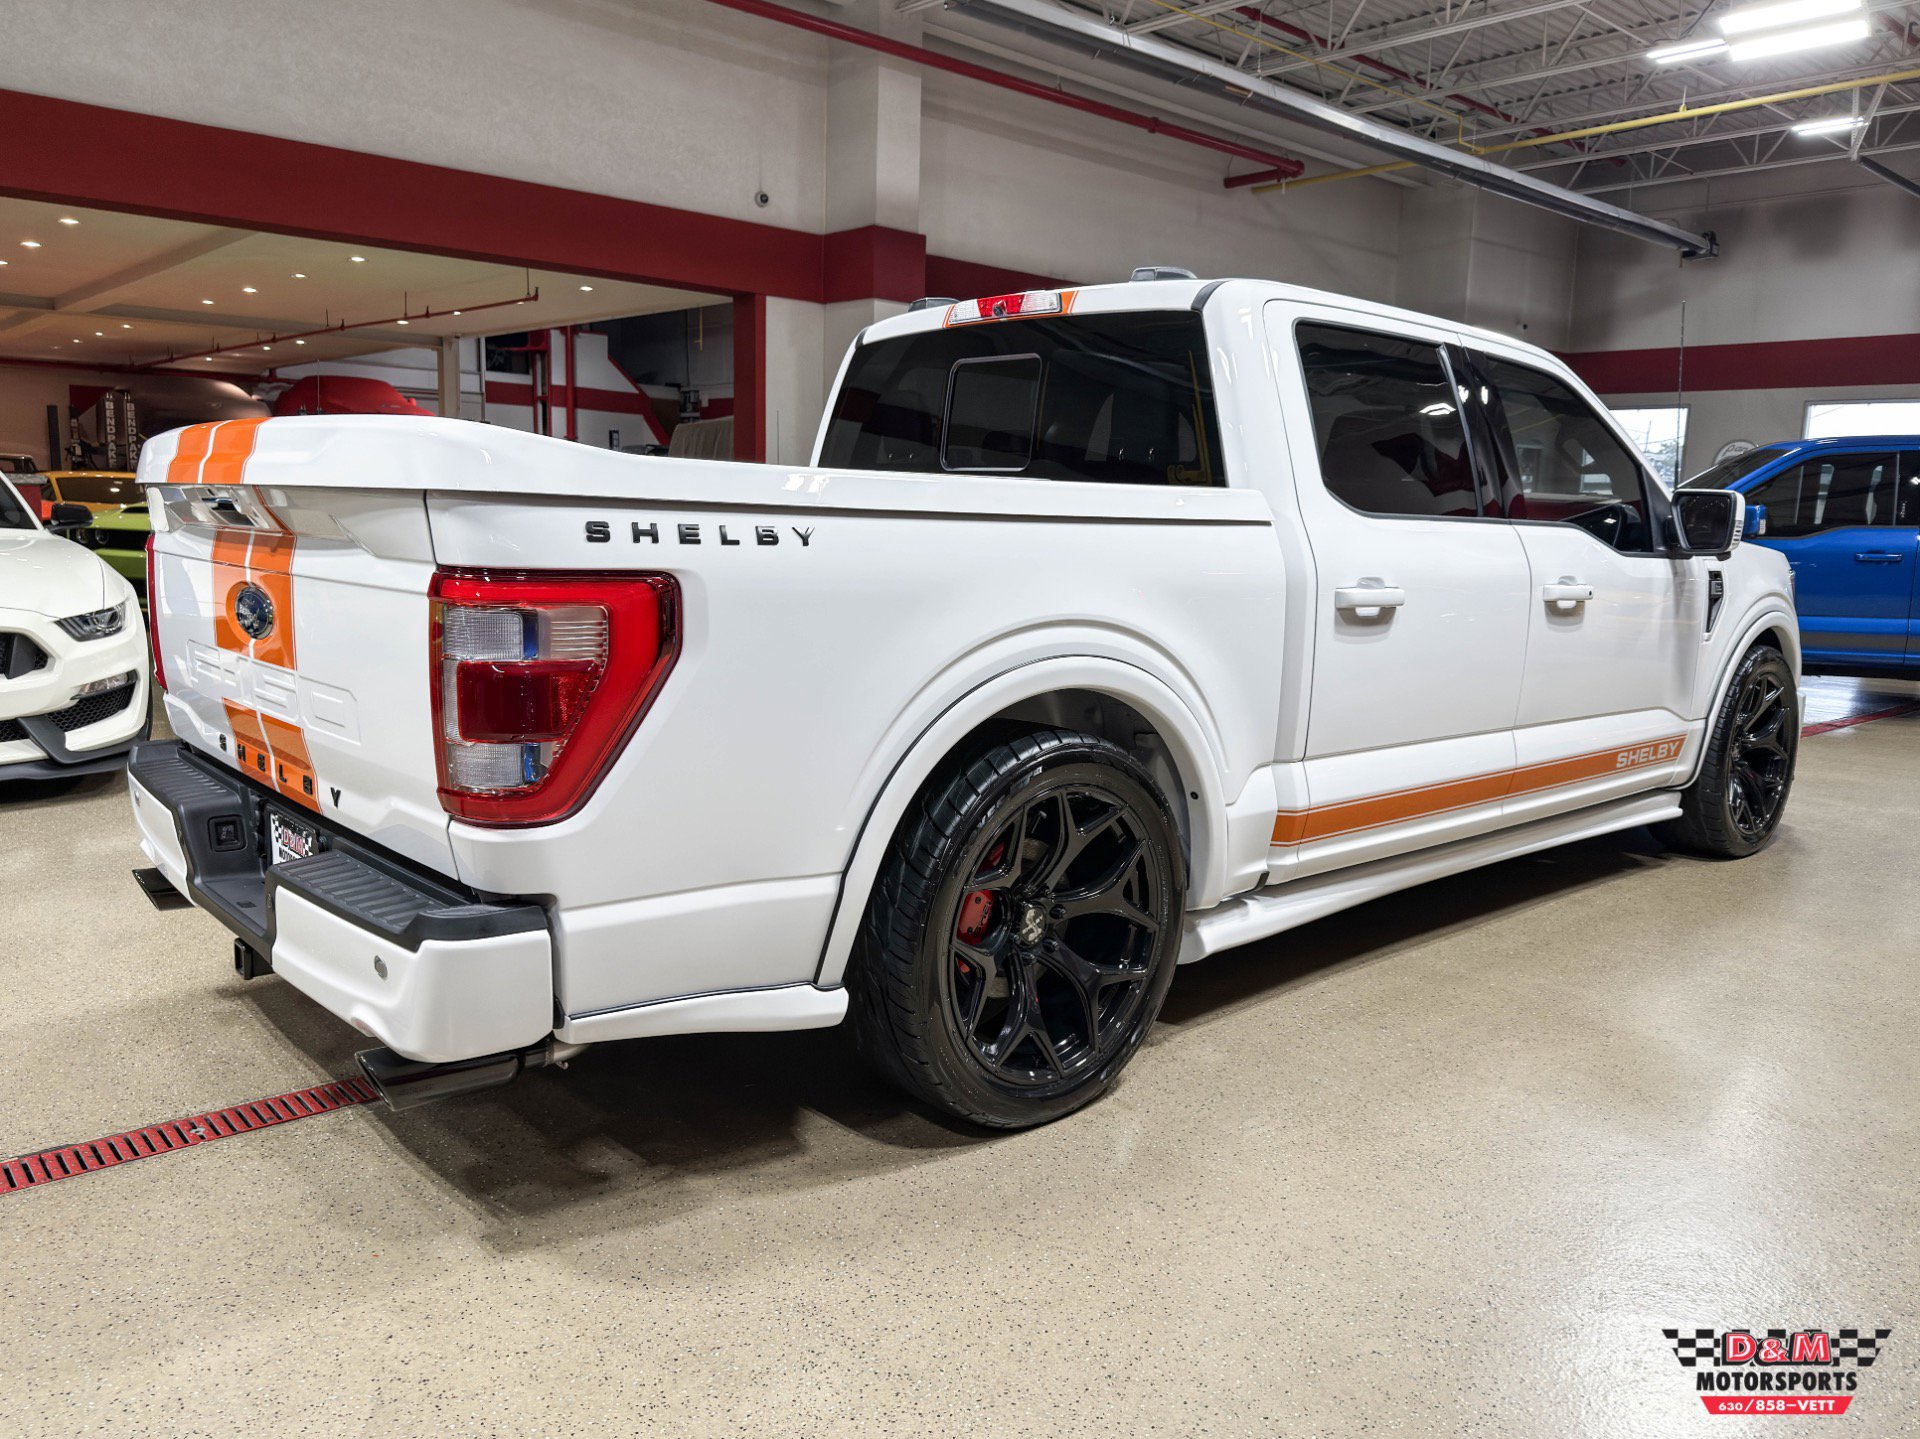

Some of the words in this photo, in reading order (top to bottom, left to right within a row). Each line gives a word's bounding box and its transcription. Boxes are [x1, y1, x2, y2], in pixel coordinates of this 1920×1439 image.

[584, 520, 816, 547] SHELBY
[1616, 741, 1680, 768] SHELBY
[218, 733, 341, 808] SHELBY
